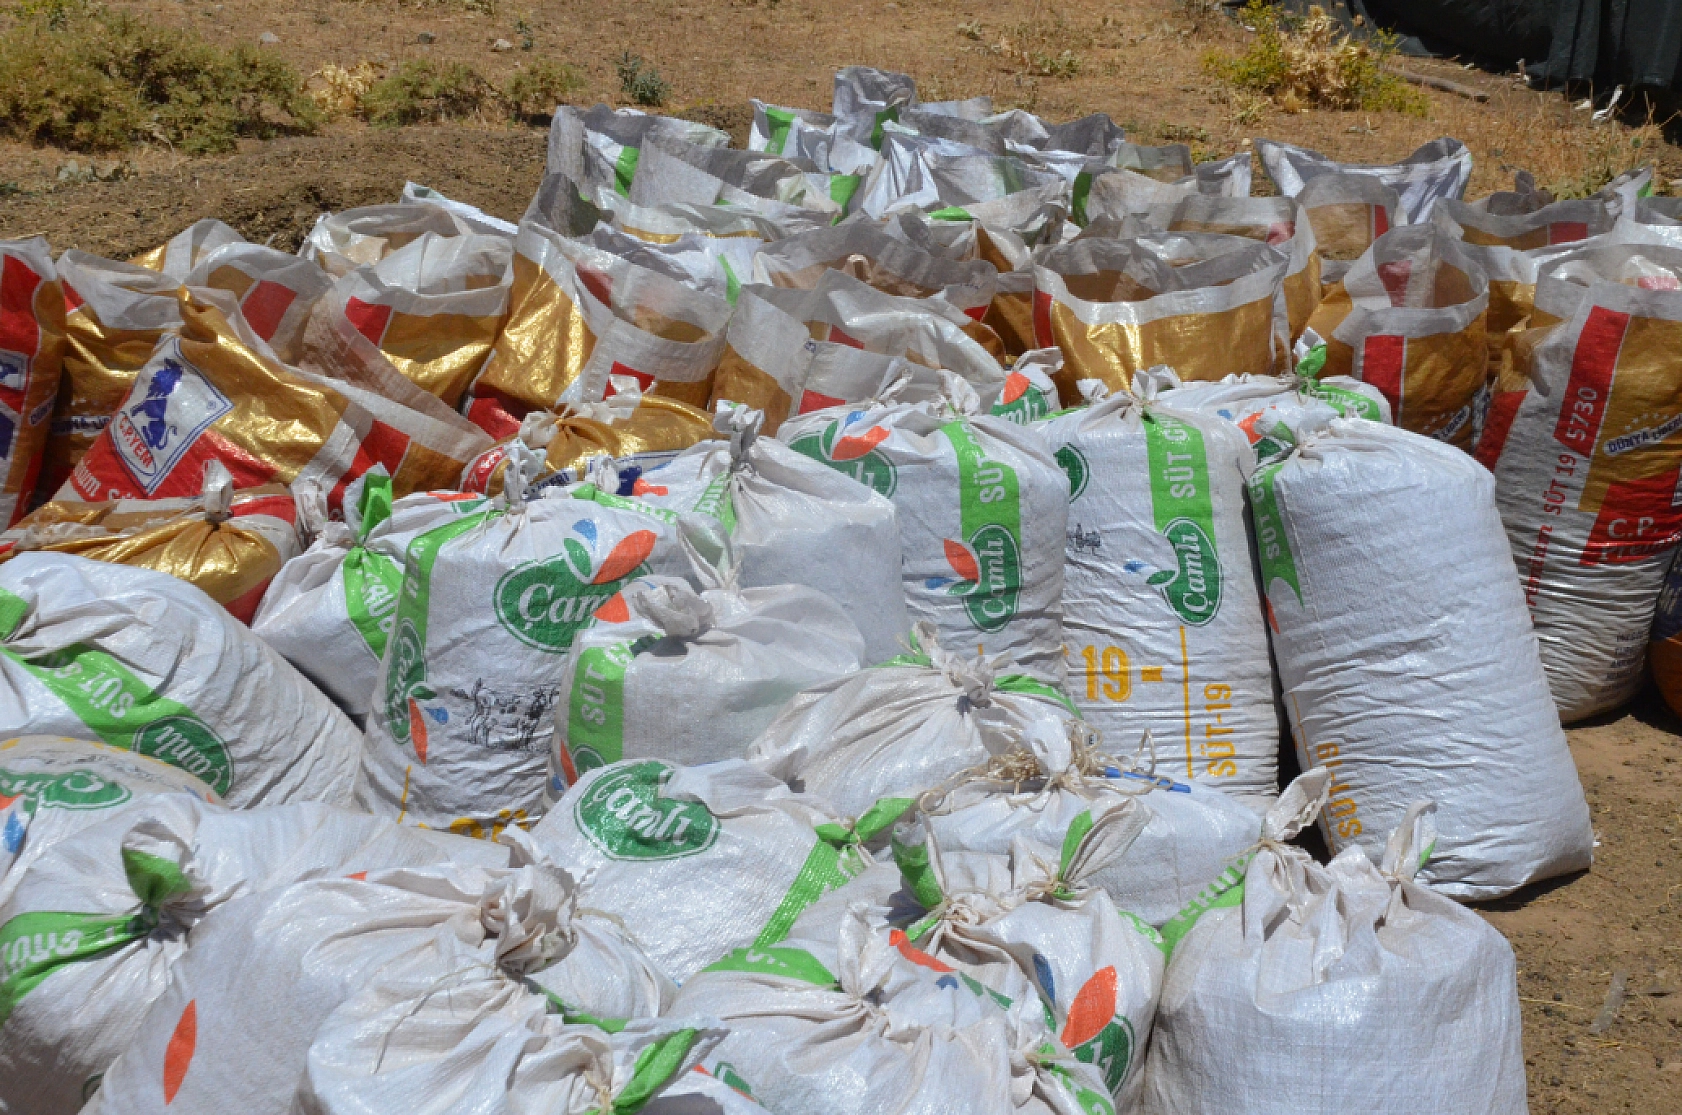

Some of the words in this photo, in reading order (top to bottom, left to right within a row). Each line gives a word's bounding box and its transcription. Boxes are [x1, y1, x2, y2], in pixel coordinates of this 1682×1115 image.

[1564, 386, 1598, 442] 5730
[1163, 450, 1197, 499] SÜT
[1555, 453, 1577, 478] 19
[1543, 478, 1569, 516] SÜT
[77, 671, 136, 719] SÜT
[1200, 683, 1238, 778] SÜT-19
